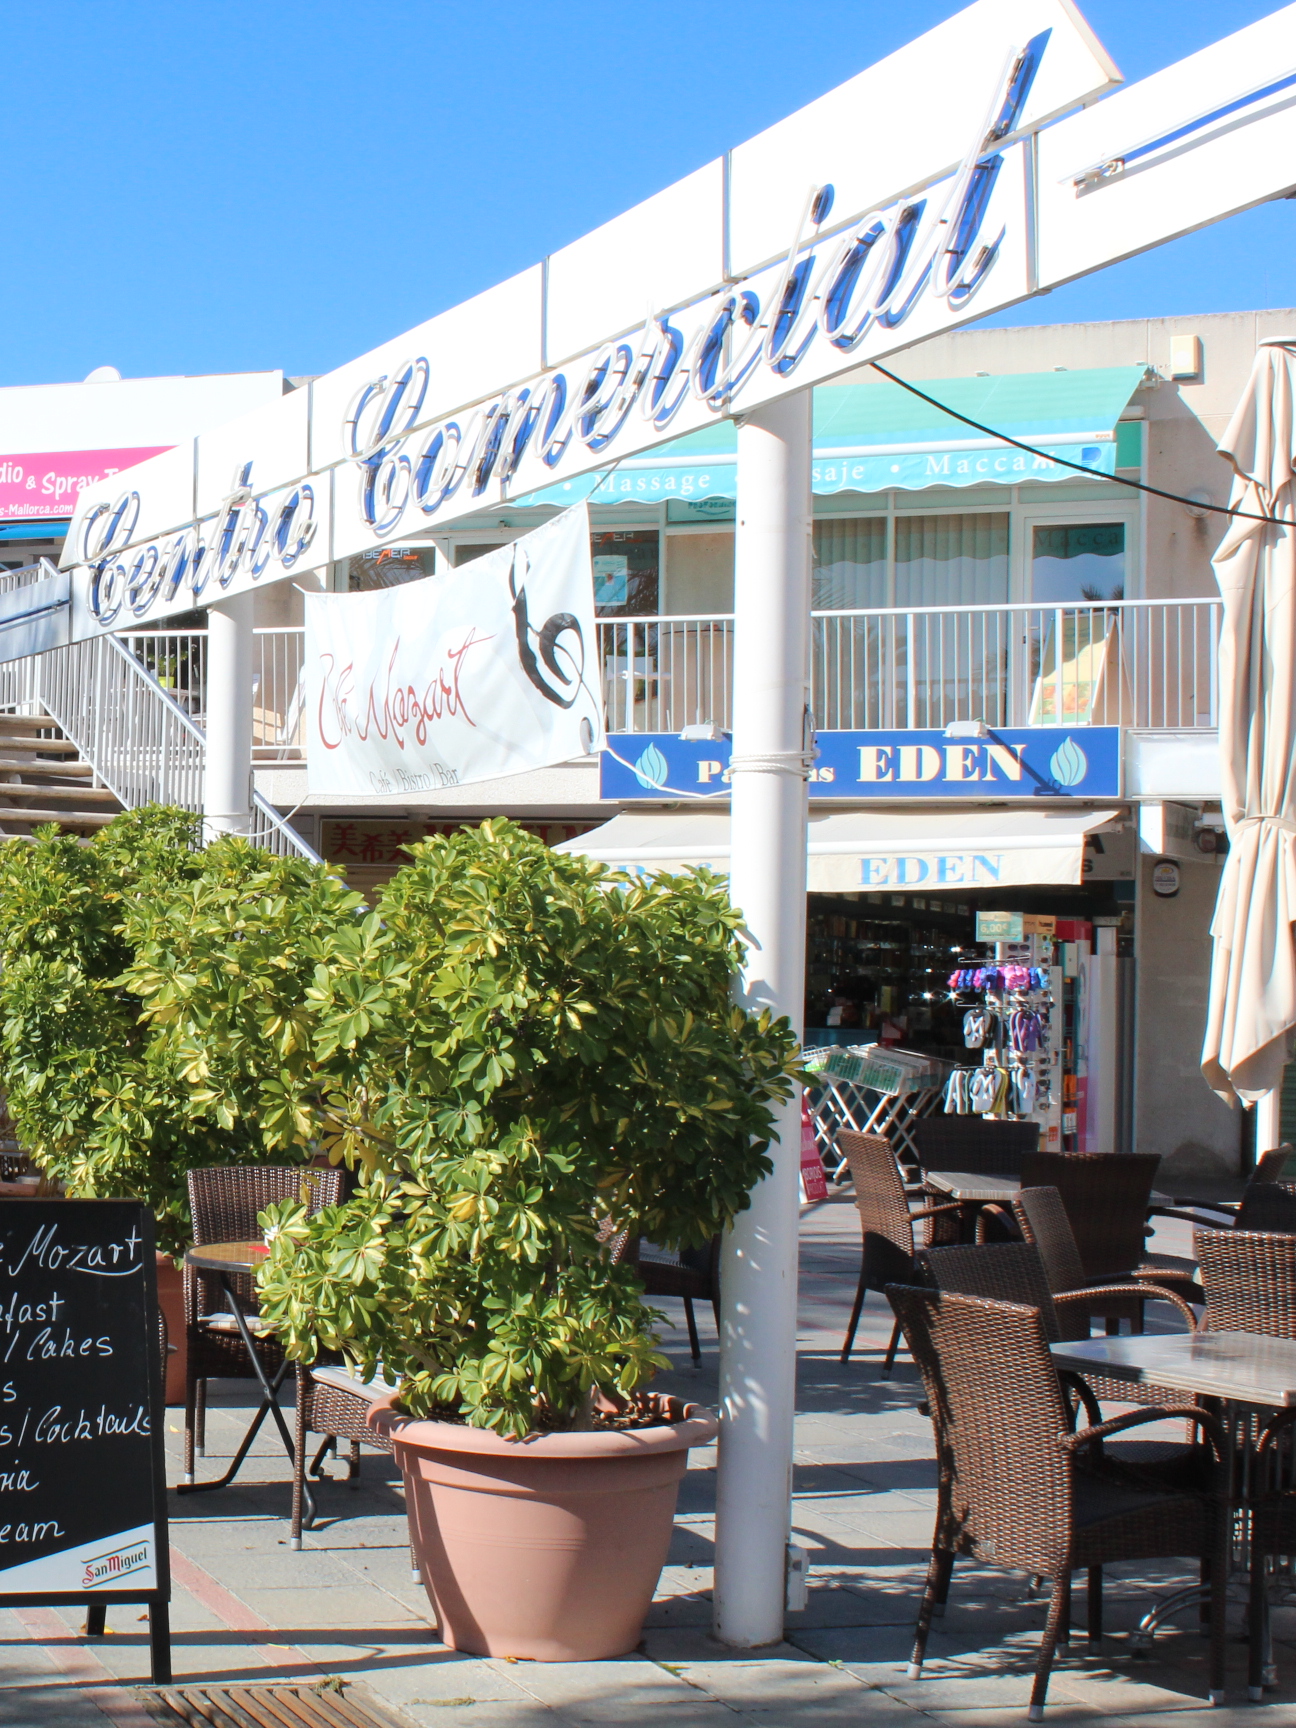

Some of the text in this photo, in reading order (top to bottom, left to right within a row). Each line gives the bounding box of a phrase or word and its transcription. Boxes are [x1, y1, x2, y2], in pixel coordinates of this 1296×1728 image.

[75, 27, 1052, 627] Centro Comercial
[25, 475, 37, 489] &
[593, 473, 711, 496] Massage
[355, 627, 498, 750] Mozart
[396, 768, 431, 791] Bistro
[434, 762, 459, 786] Bar
[856, 744, 1027, 783] EDEN
[857, 855, 1005, 886] EDEN
[8, 1223, 143, 1276] Mozart
[26, 1327, 114, 1361] Cakes
